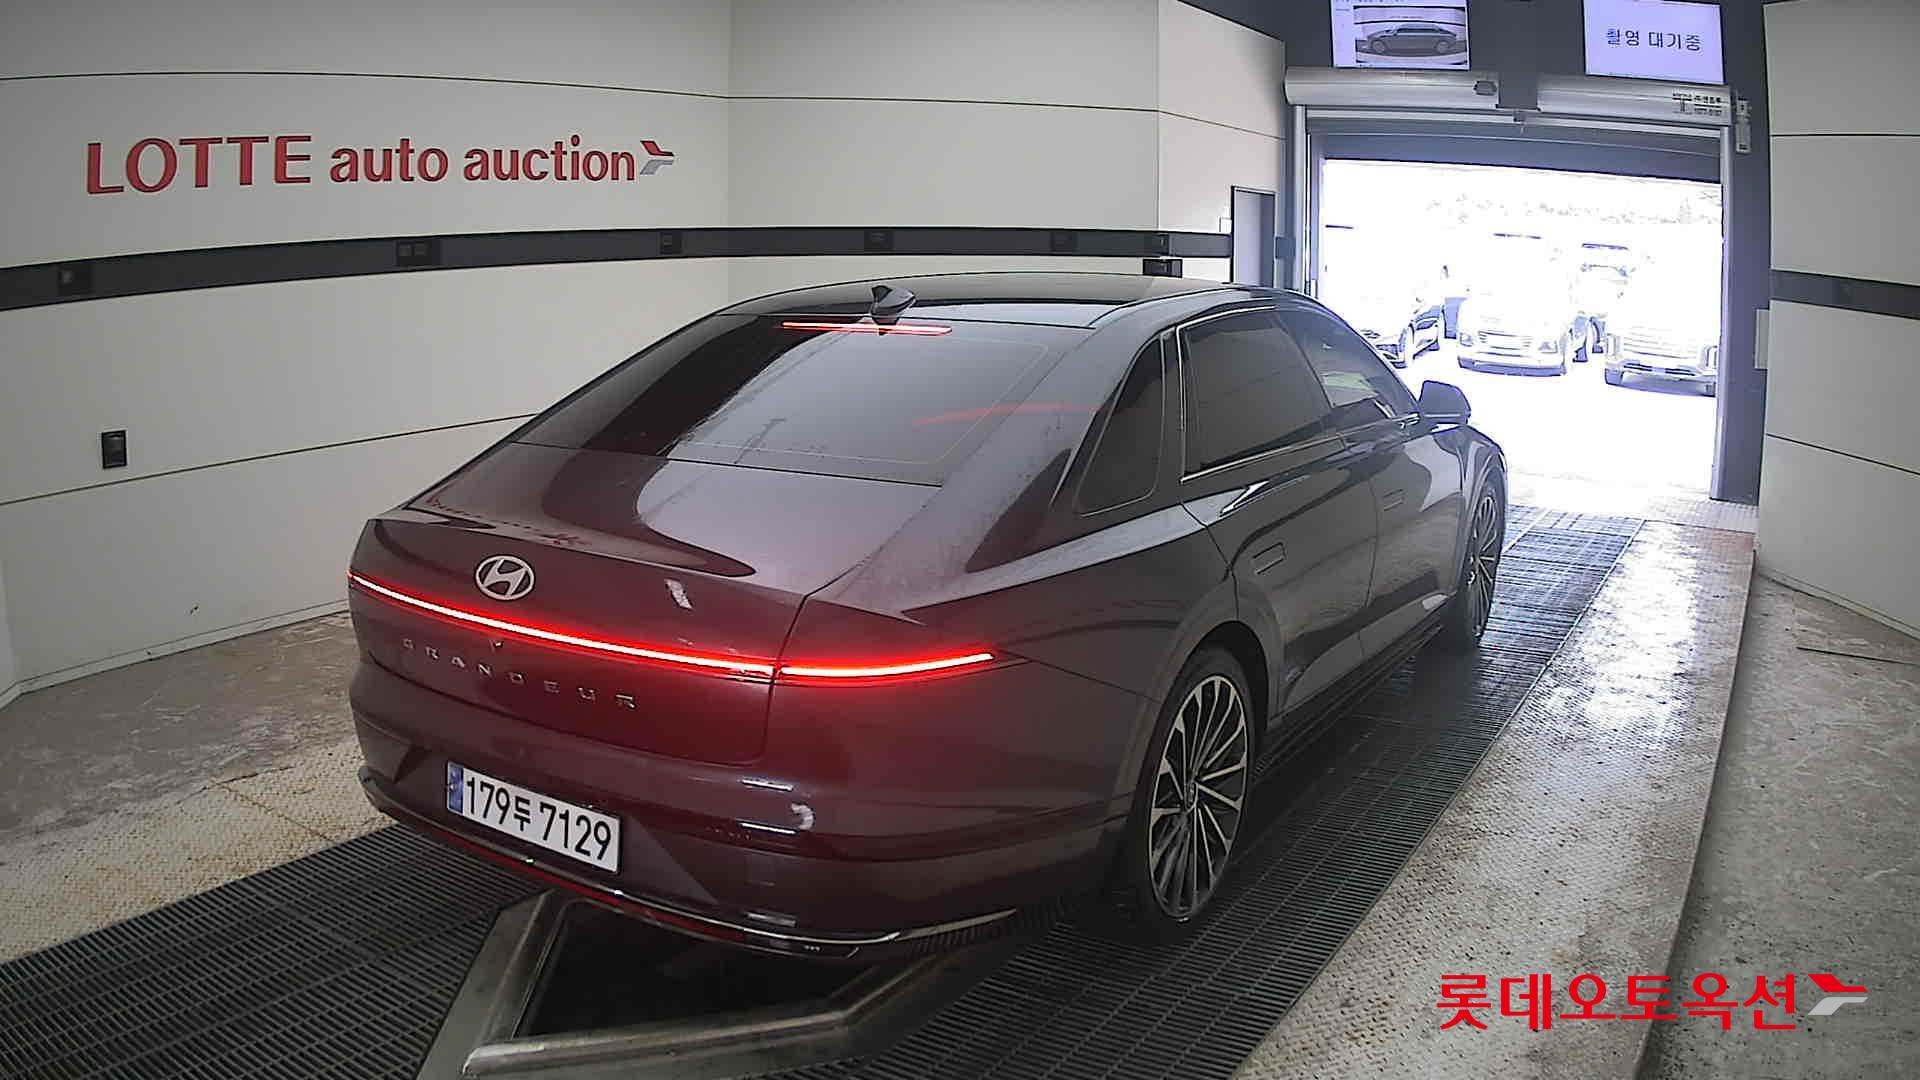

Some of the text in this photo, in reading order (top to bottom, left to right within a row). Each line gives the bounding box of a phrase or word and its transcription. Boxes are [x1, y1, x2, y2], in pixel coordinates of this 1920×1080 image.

[1648, 31, 1701, 51] 대기중
[87, 134, 636, 194] LOTTE auto auction
[402, 637, 638, 709] GRANDEUR
[467, 776, 612, 860] 179두 7129
